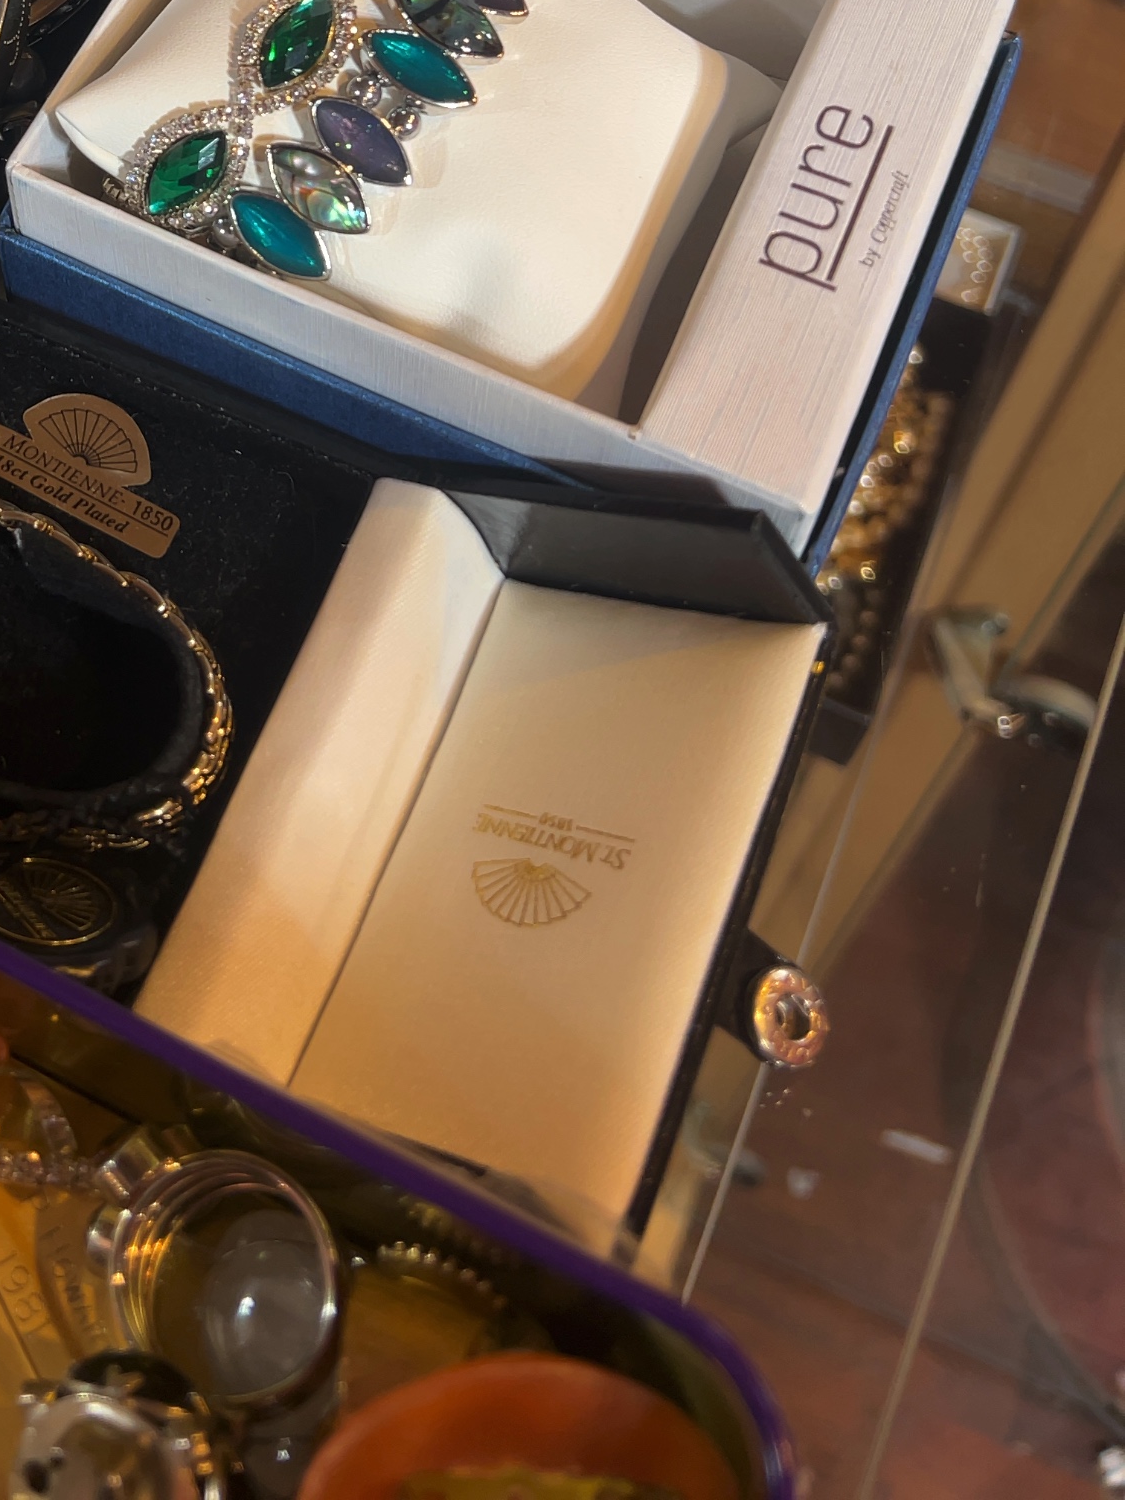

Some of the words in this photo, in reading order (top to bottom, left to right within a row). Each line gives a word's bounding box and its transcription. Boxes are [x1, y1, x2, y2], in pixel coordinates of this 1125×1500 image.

[758, 104, 874, 292] pure
[858, 247, 881, 269] by
[870, 170, 909, 245] Coppercraft
[29, 474, 75, 503] Gold
[73, 499, 130, 534] Plated
[131, 501, 174, 532] 1850
